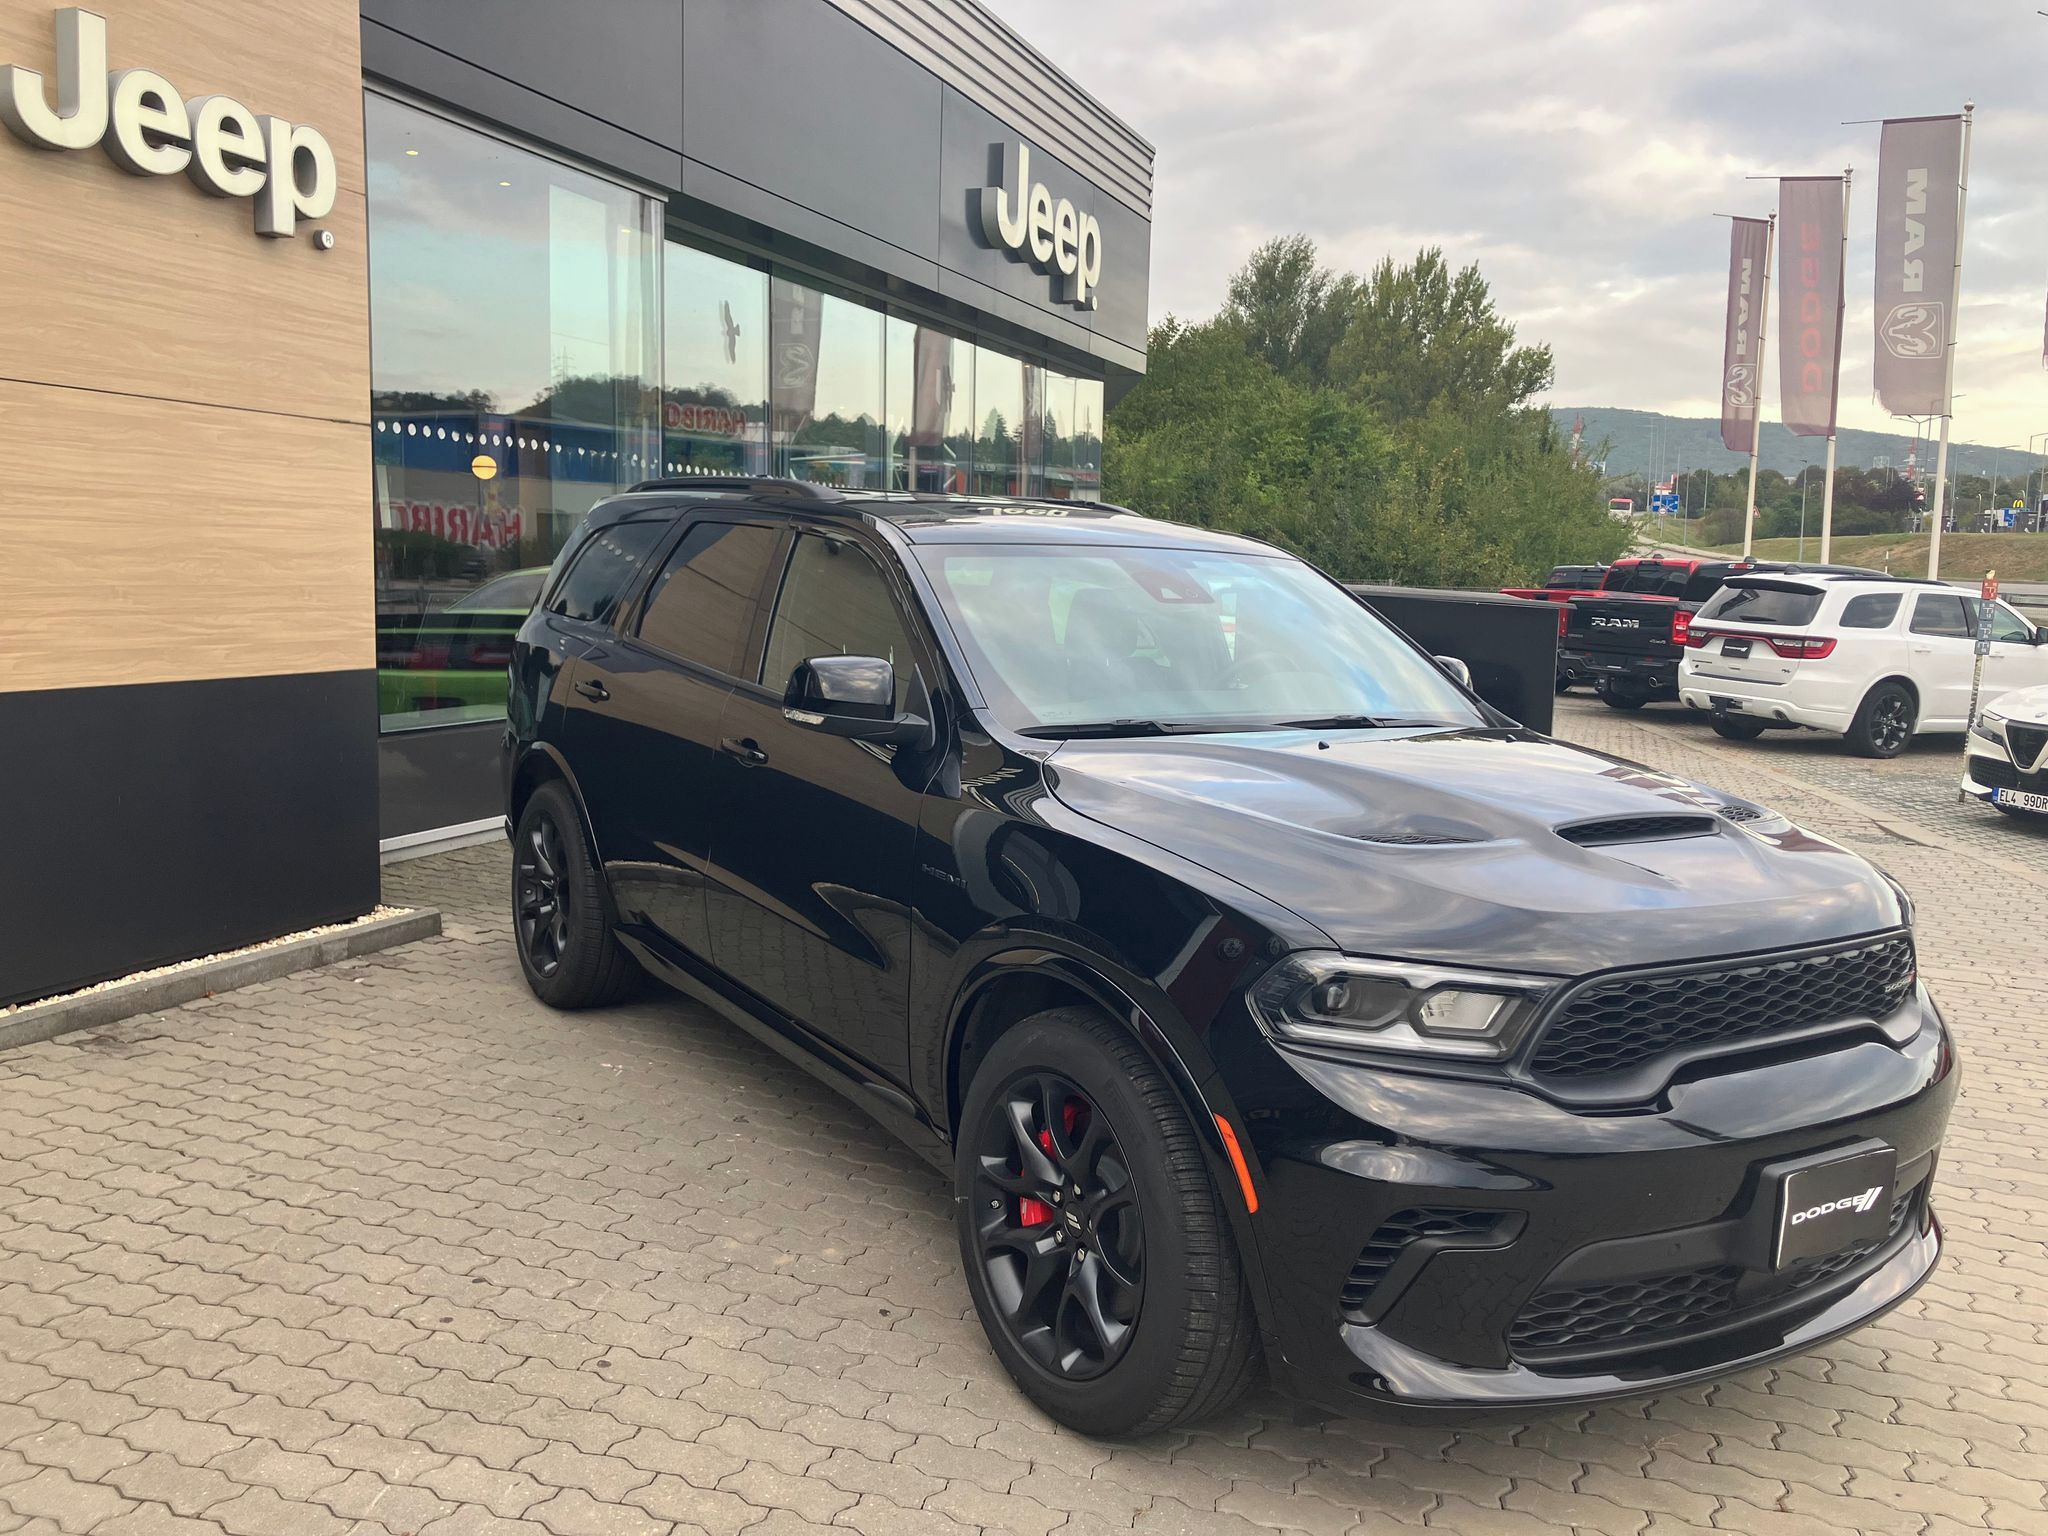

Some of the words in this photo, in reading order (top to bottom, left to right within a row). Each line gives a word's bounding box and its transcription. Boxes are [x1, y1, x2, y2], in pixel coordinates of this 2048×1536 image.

[1, 7, 336, 238] Jeep
[982, 141, 1102, 303] Jeep
[1591, 616, 1640, 629] RAM
[2000, 790, 2016, 804] EL4
[2023, 794, 2048, 810] 99DR
[1791, 1192, 1872, 1225] DODGE
